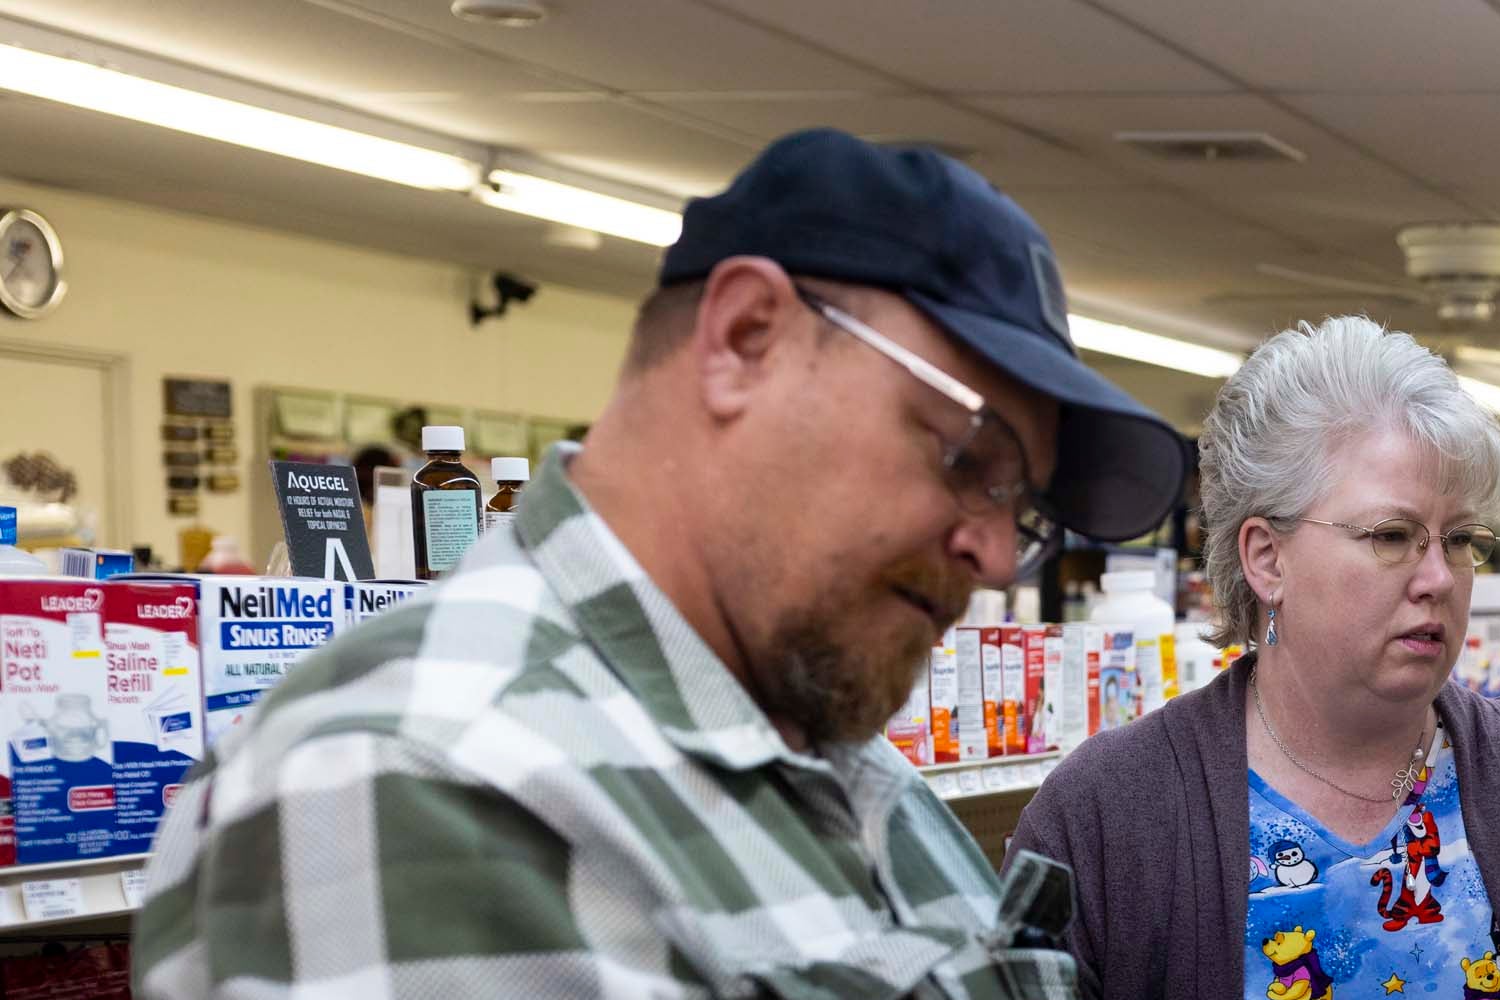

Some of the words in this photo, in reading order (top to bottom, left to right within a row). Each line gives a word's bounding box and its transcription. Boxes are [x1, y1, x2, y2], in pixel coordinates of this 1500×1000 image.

[288, 472, 349, 492] AQUEGEL
[298, 508, 313, 517] RELIEF
[41, 596, 93, 611] LEADER
[137, 604, 185, 618] LEADER
[220, 587, 332, 618] NeilMed
[230, 624, 279, 647] SINUS
[282, 625, 326, 646] RINSE
[5, 642, 48, 658] Neti
[106, 653, 158, 671] Saline
[225, 664, 241, 676] ALL
[243, 663, 281, 676] NATURAL
[7, 662, 41, 681] Pot
[107, 675, 153, 692] Refill
